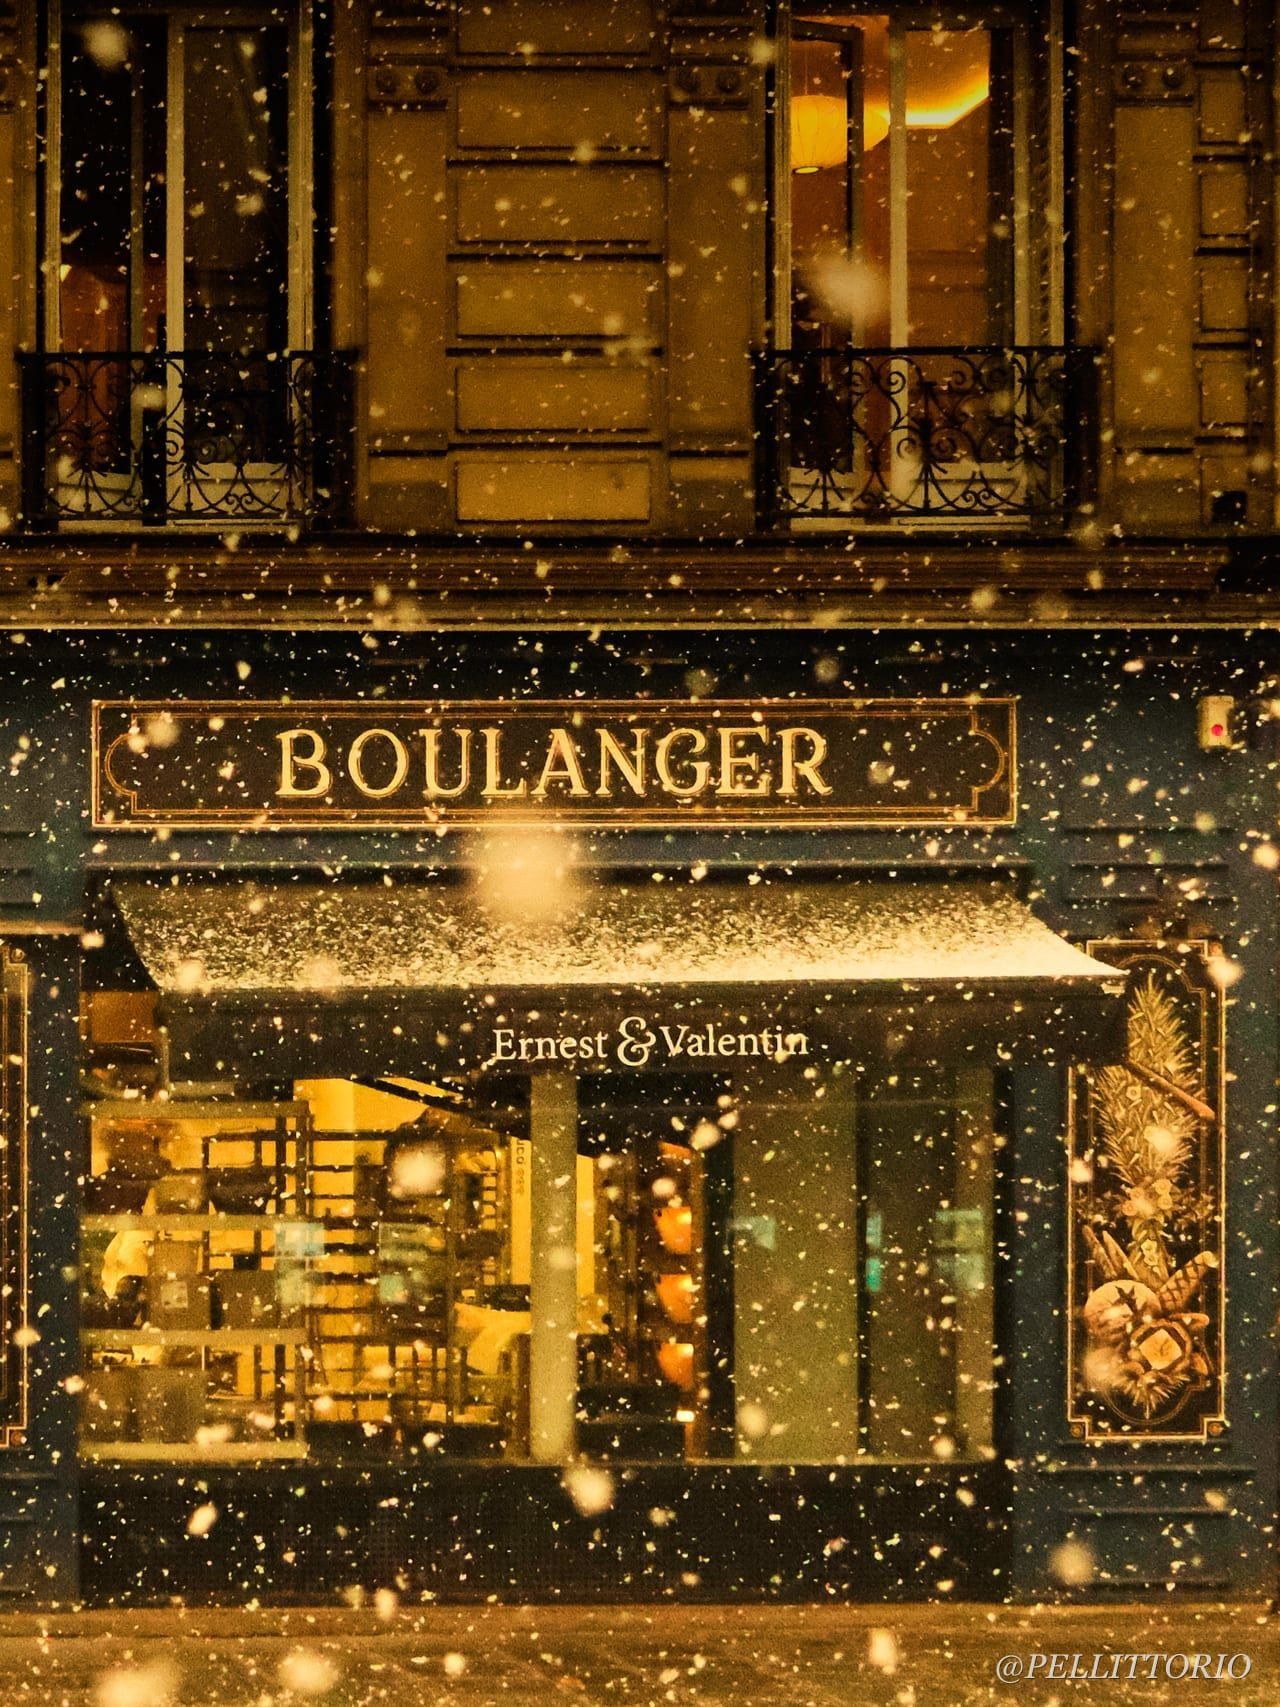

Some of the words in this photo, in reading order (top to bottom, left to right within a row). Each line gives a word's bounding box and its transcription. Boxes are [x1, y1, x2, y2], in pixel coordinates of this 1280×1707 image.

[275, 727, 833, 798] BOULANGER
[492, 1028, 608, 1061] Ernest
[617, 1016, 656, 1067] &
[660, 1023, 809, 1058] Valentin
